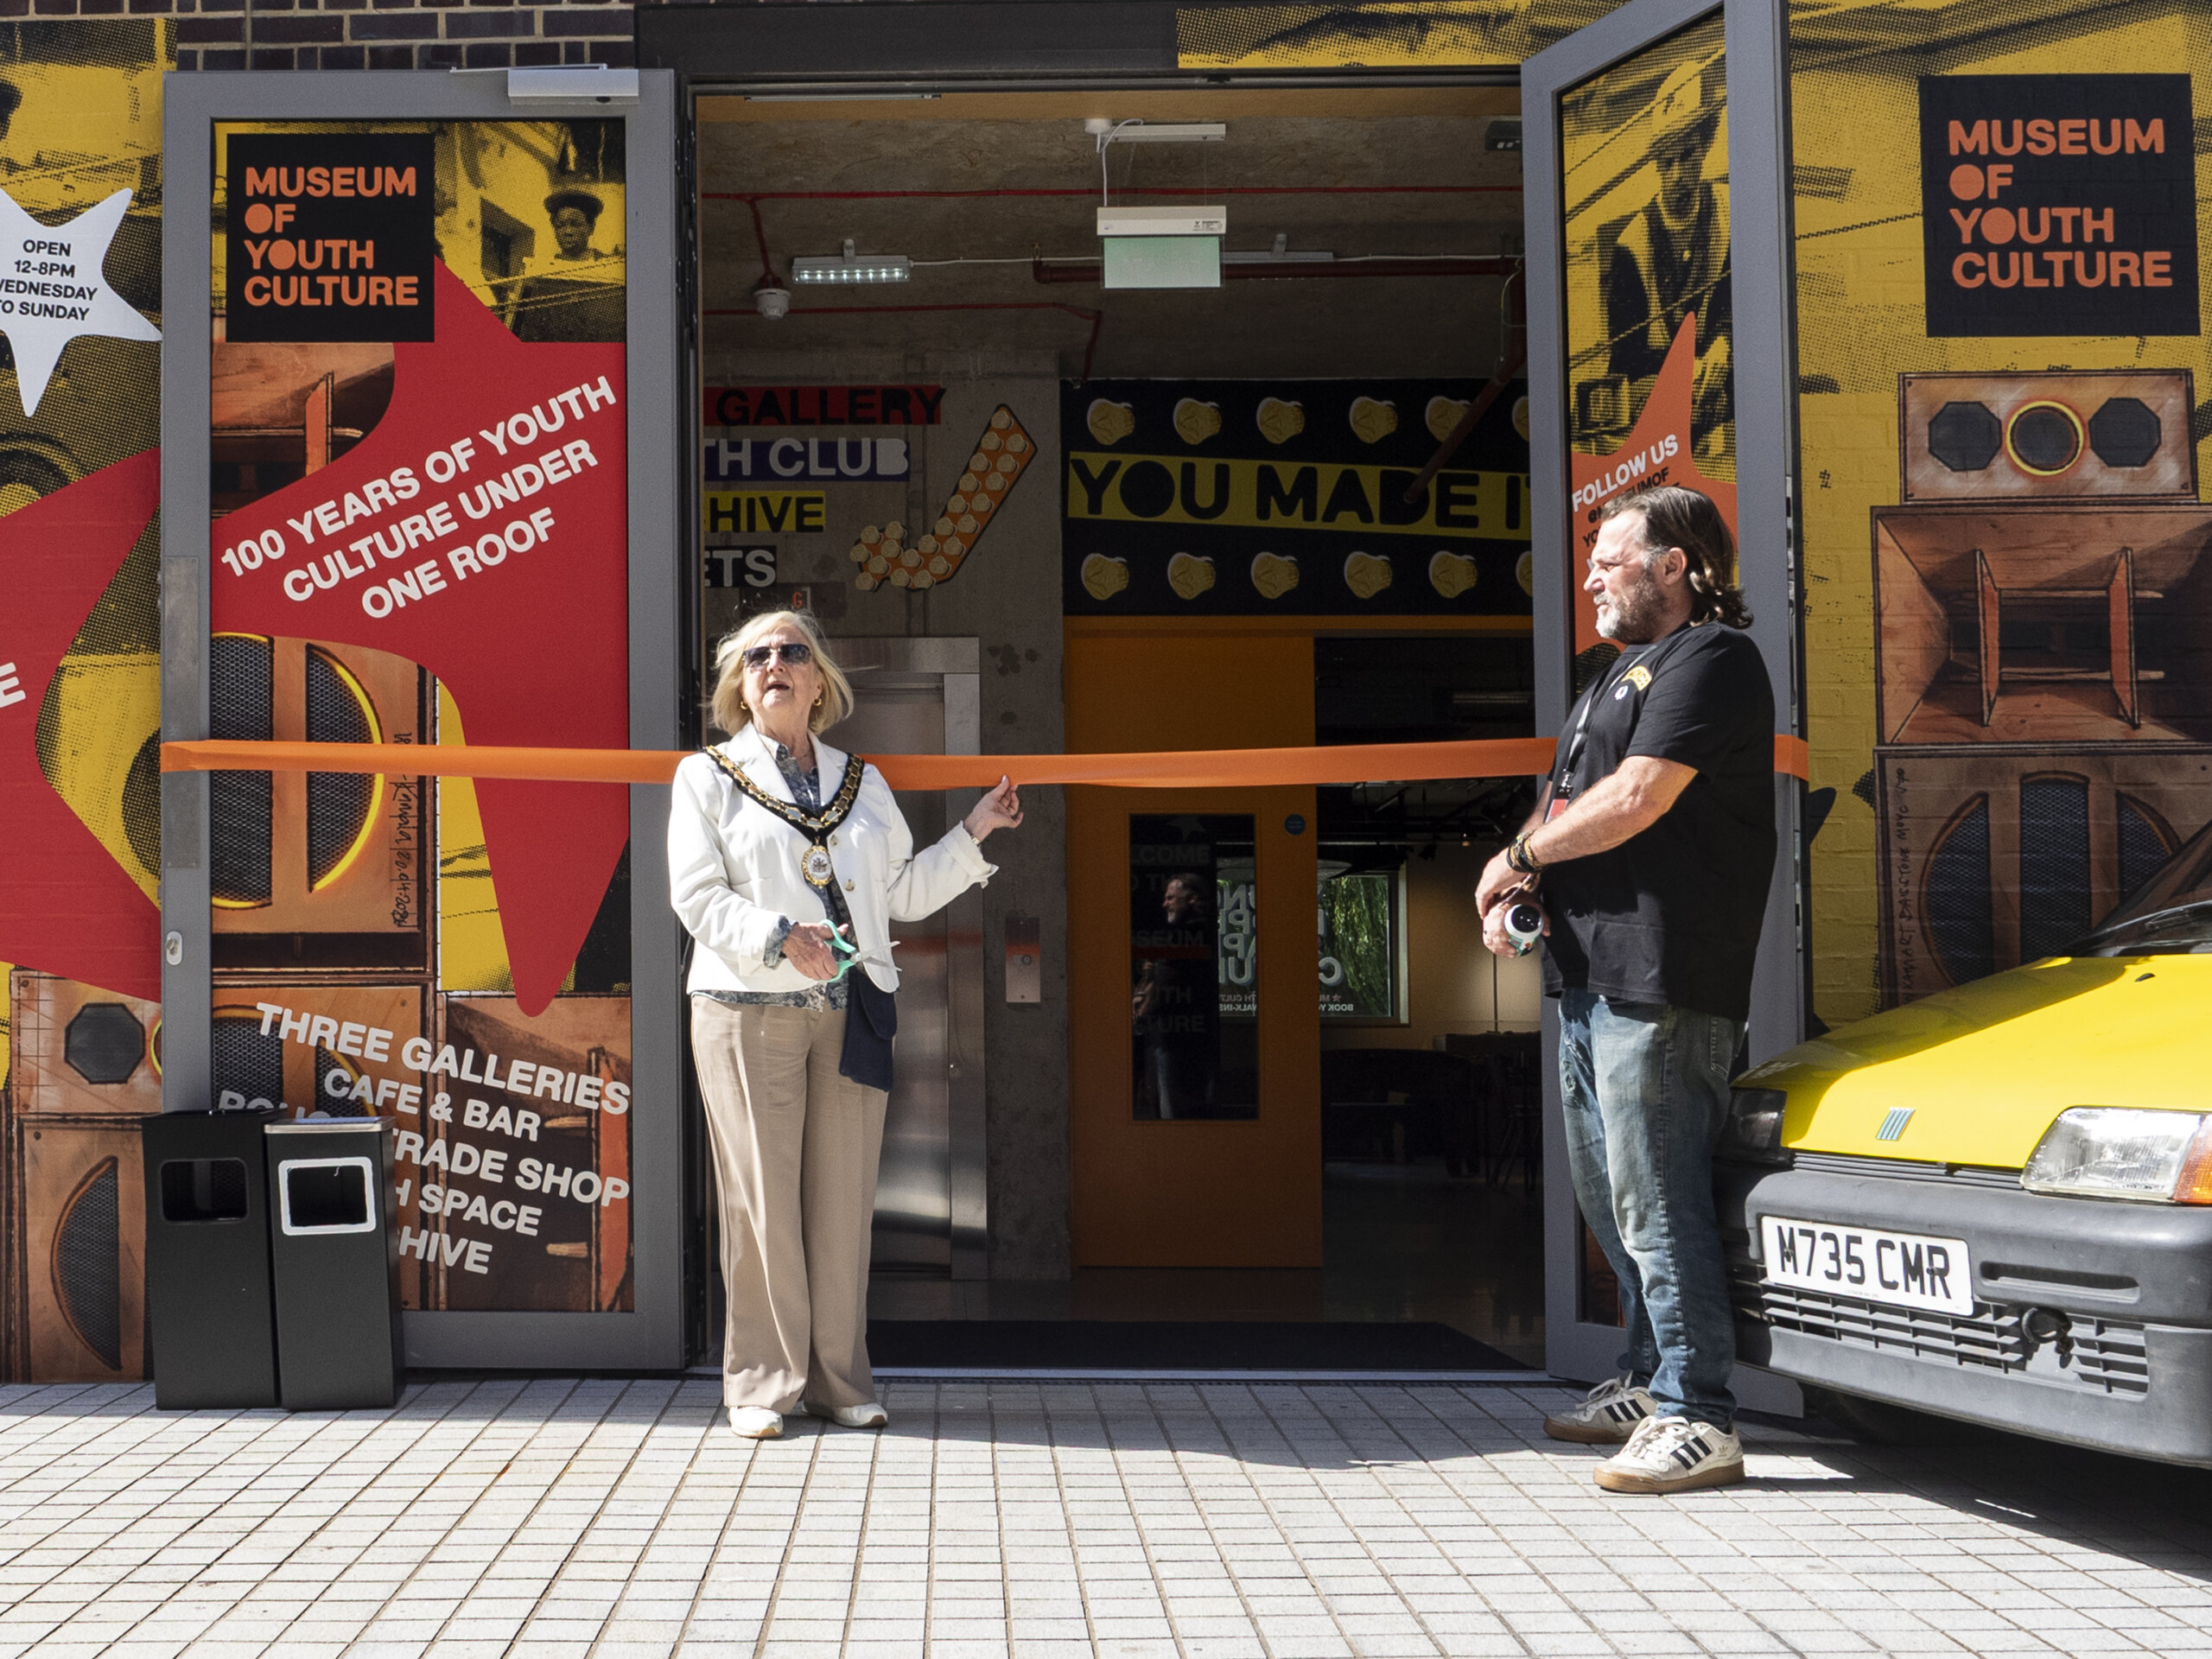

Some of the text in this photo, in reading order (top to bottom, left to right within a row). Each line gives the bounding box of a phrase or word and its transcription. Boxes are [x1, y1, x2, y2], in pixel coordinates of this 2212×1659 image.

[1948, 118, 2164, 156] MUSEUM
[245, 167, 416, 197] MUSEUM
[1948, 163, 2013, 200] OF
[245, 203, 296, 233] OF
[1949, 207, 2114, 245] YOUTH
[22, 239, 72, 257] OPEN
[244, 239, 374, 270] YOUTH
[15, 260, 76, 278] 12-8PM
[1952, 251, 2172, 288] CULTURE
[0, 299, 90, 321] O SUNDAY
[245, 276, 418, 306] CULTURE
[716, 388, 947, 426] GALLERY
[769, 437, 909, 476] CLUB
[1572, 434, 1679, 512] FOLLOW US
[220, 375, 617, 577] 100 YEARS OF YOUTH
[1070, 459, 1530, 531] YOU MADE I
[283, 501, 459, 602] CULTURE
[458, 439, 599, 520] UNDER
[709, 496, 825, 533] HIVE
[361, 506, 556, 619] ONE ROOF
[792, 591, 803, 608] G
[256, 1001, 394, 1064] THREE
[401, 1036, 631, 1116] GALLERIES
[324, 1068, 423, 1116] CAFE
[429, 1092, 454, 1123] &
[463, 1098, 541, 1142] BAR
[393, 1128, 630, 1208] RADE SHOP
[418, 1184, 543, 1237] SPACE
[397, 1227, 493, 1275] HIVE
[1777, 1224, 1953, 1300] M735 CMR
